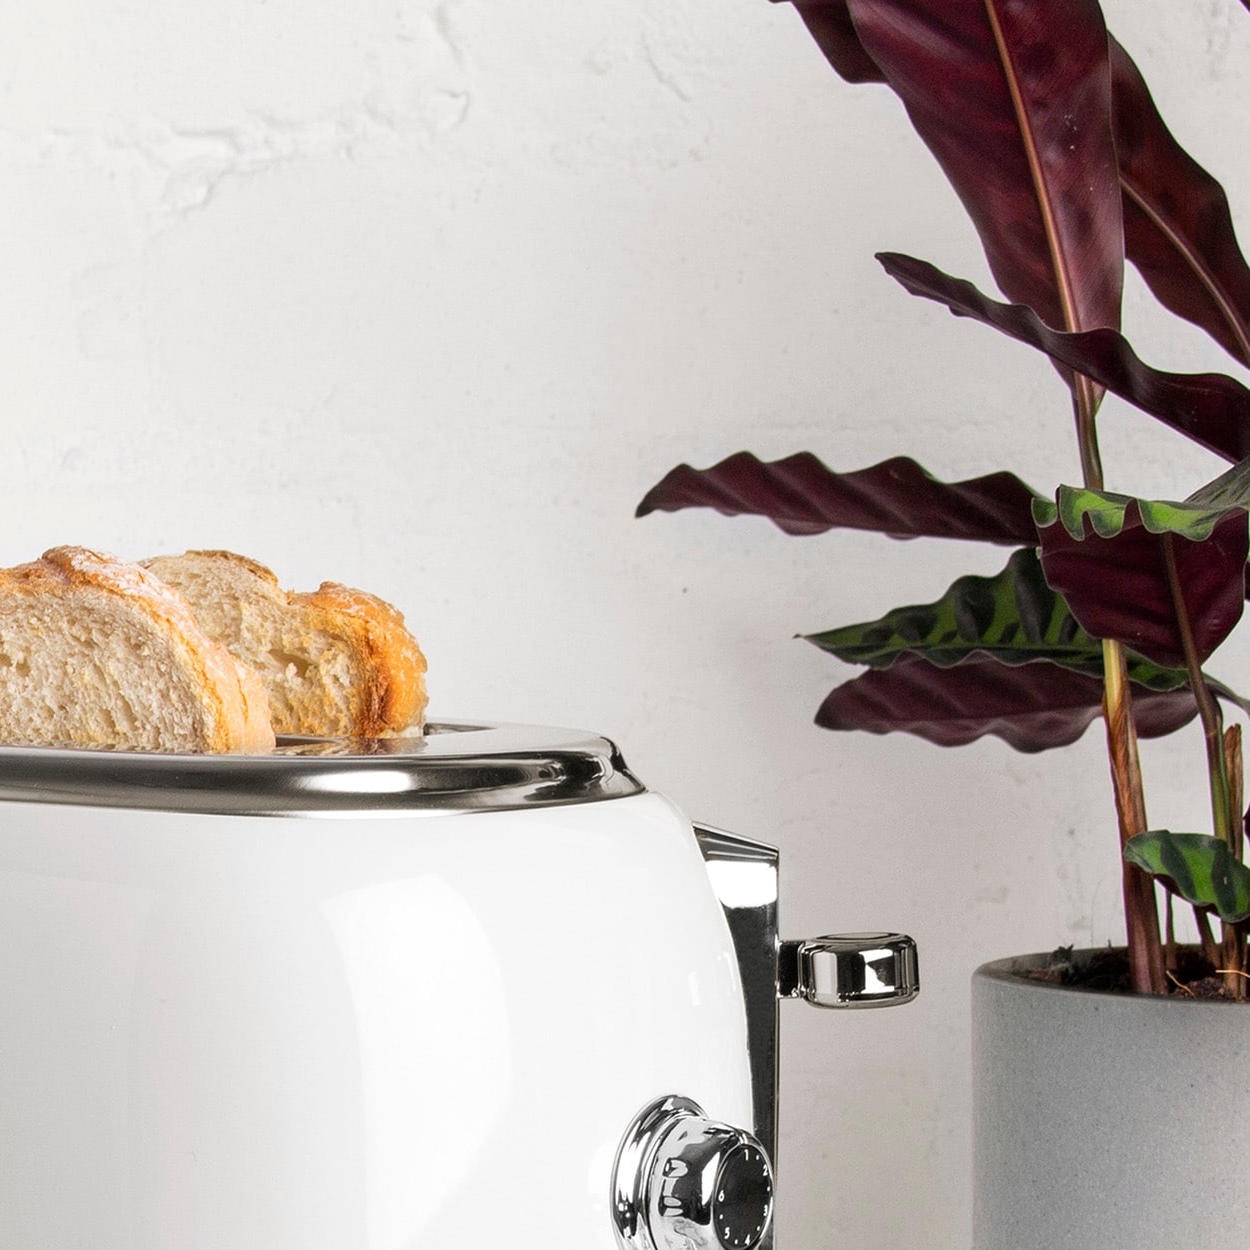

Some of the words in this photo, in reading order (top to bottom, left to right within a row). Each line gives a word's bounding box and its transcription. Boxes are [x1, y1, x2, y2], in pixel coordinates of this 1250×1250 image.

[744, 1148, 749, 1161] 1
[762, 1164, 768, 1176] 2
[718, 1189, 725, 1202] 6
[762, 1204, 768, 1217] 3
[724, 1226, 730, 1240] 5
[744, 1233, 751, 1246] 4
